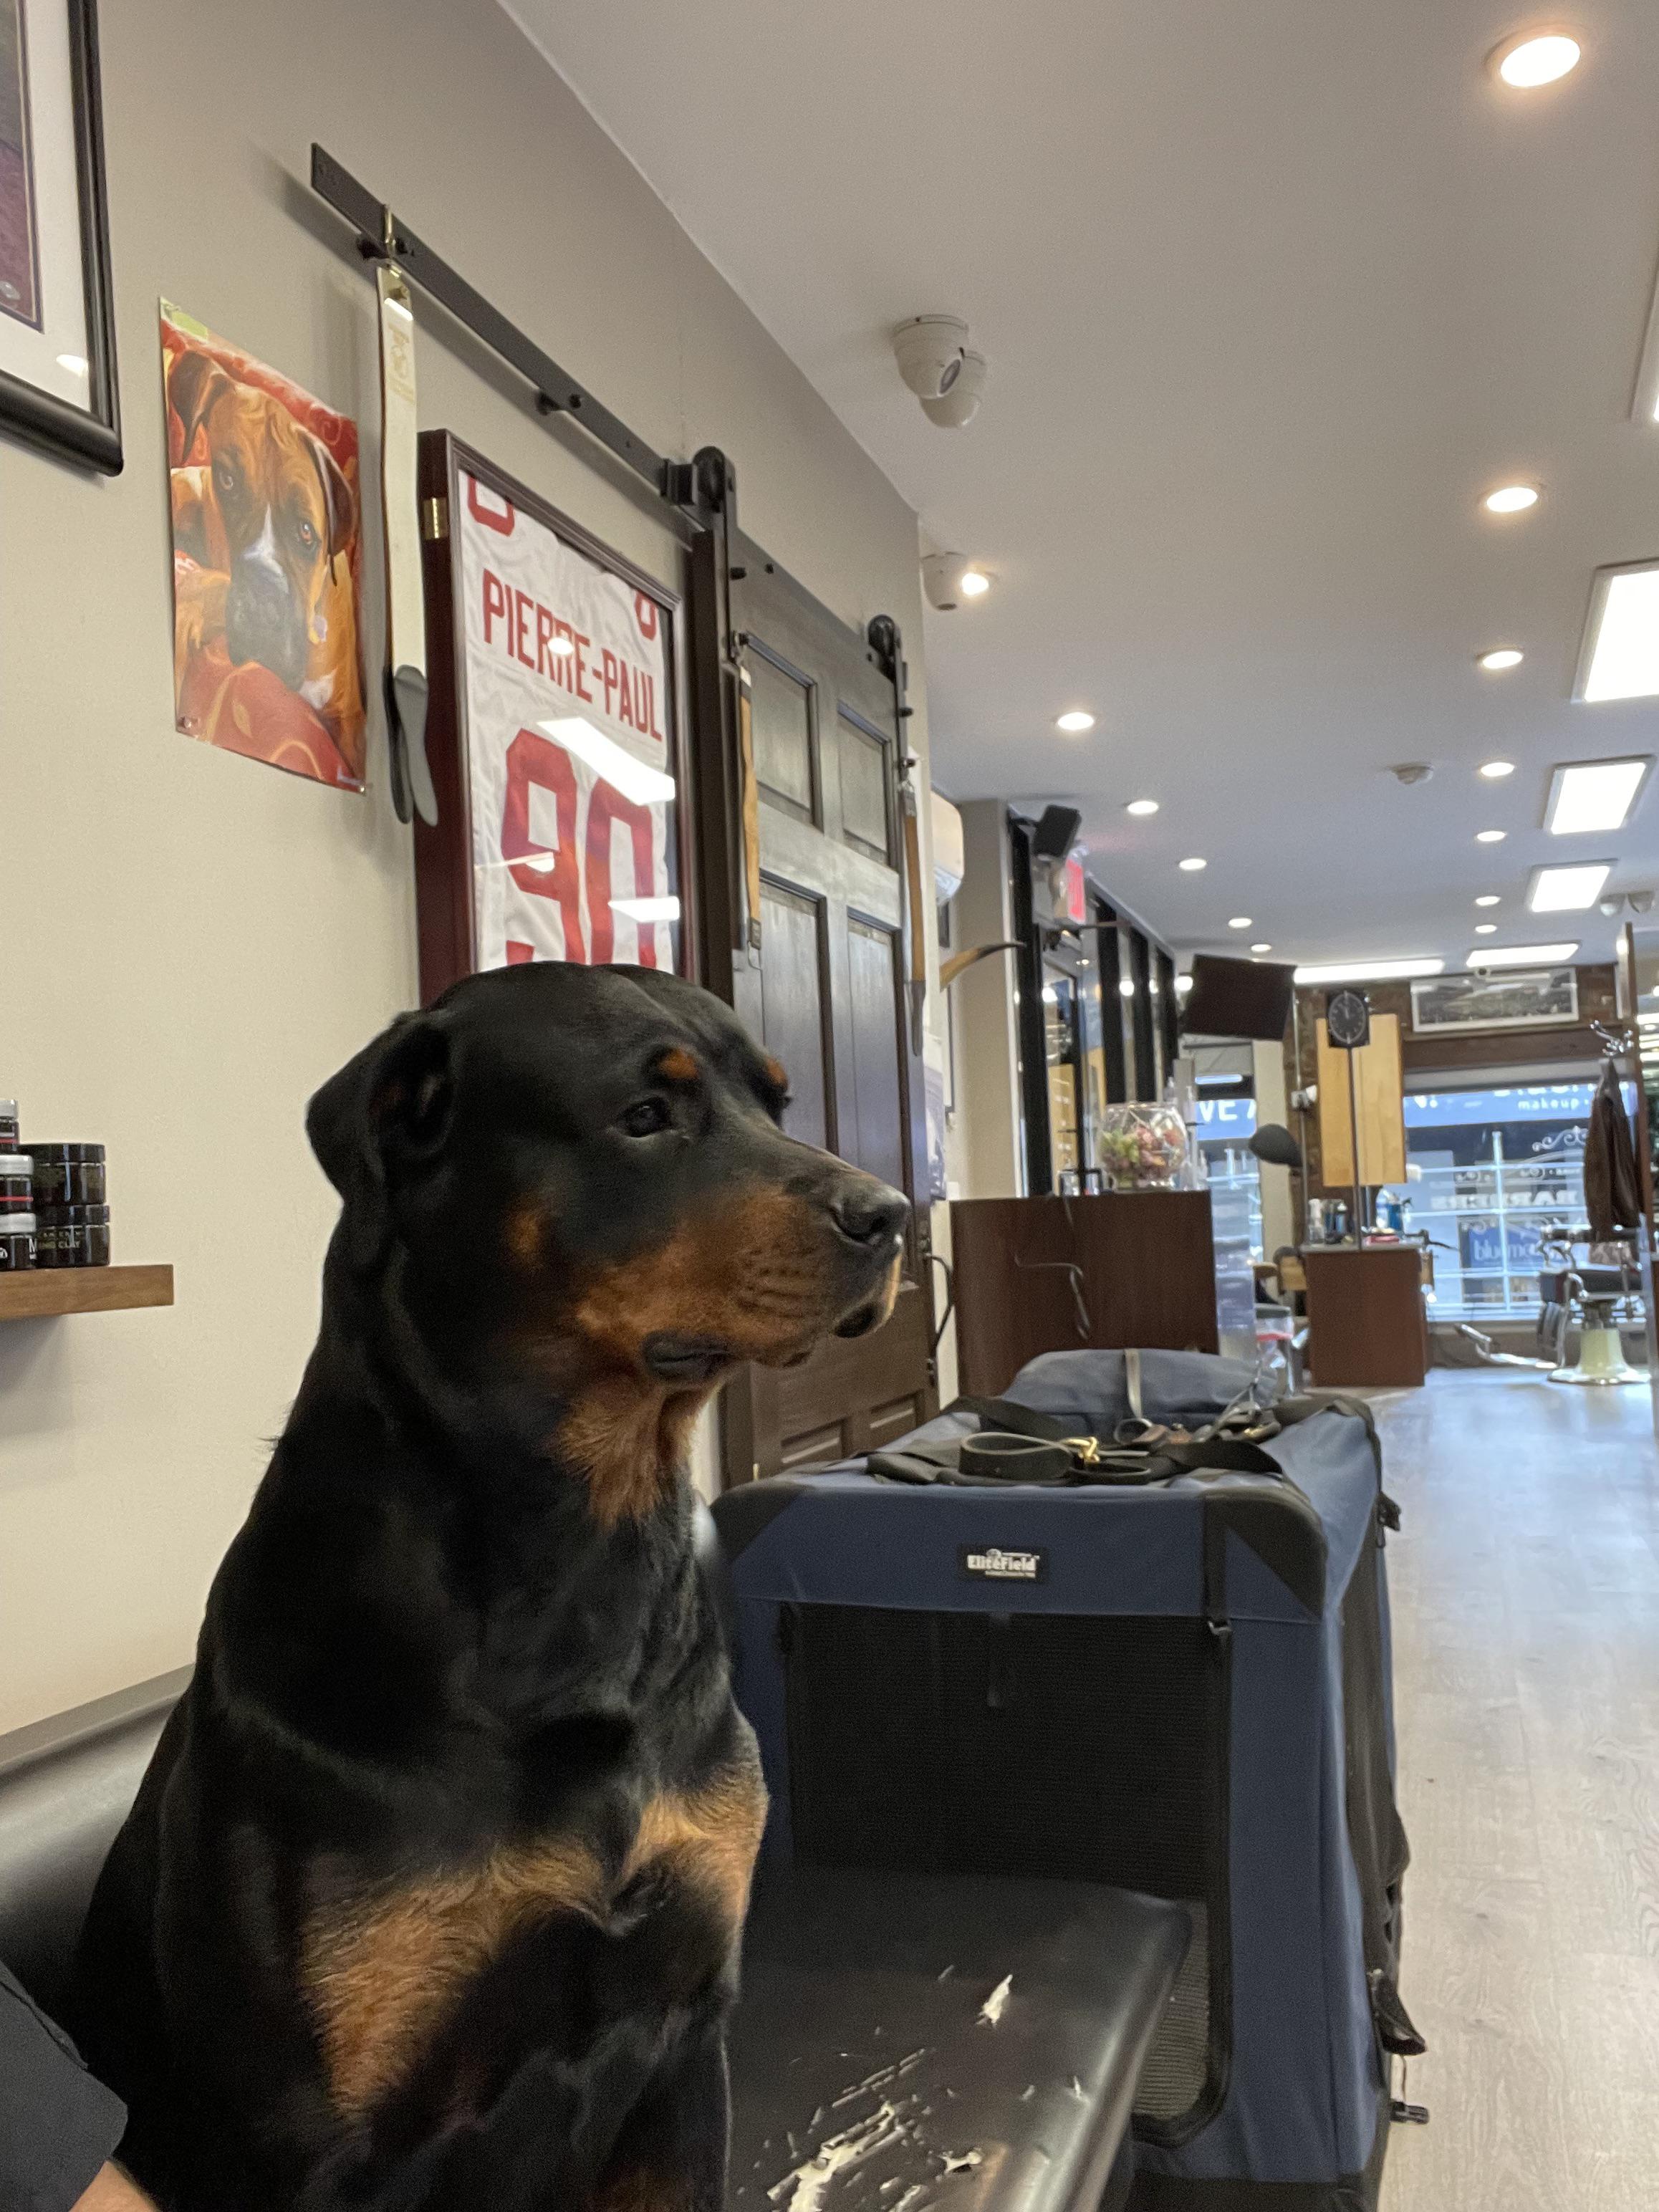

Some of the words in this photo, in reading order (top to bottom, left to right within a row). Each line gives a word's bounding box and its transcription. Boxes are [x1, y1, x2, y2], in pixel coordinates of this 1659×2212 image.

[482, 568, 663, 742] PIERRE-PAUL
[501, 728, 657, 967] 90
[1518, 1098, 1579, 1110] makeup
